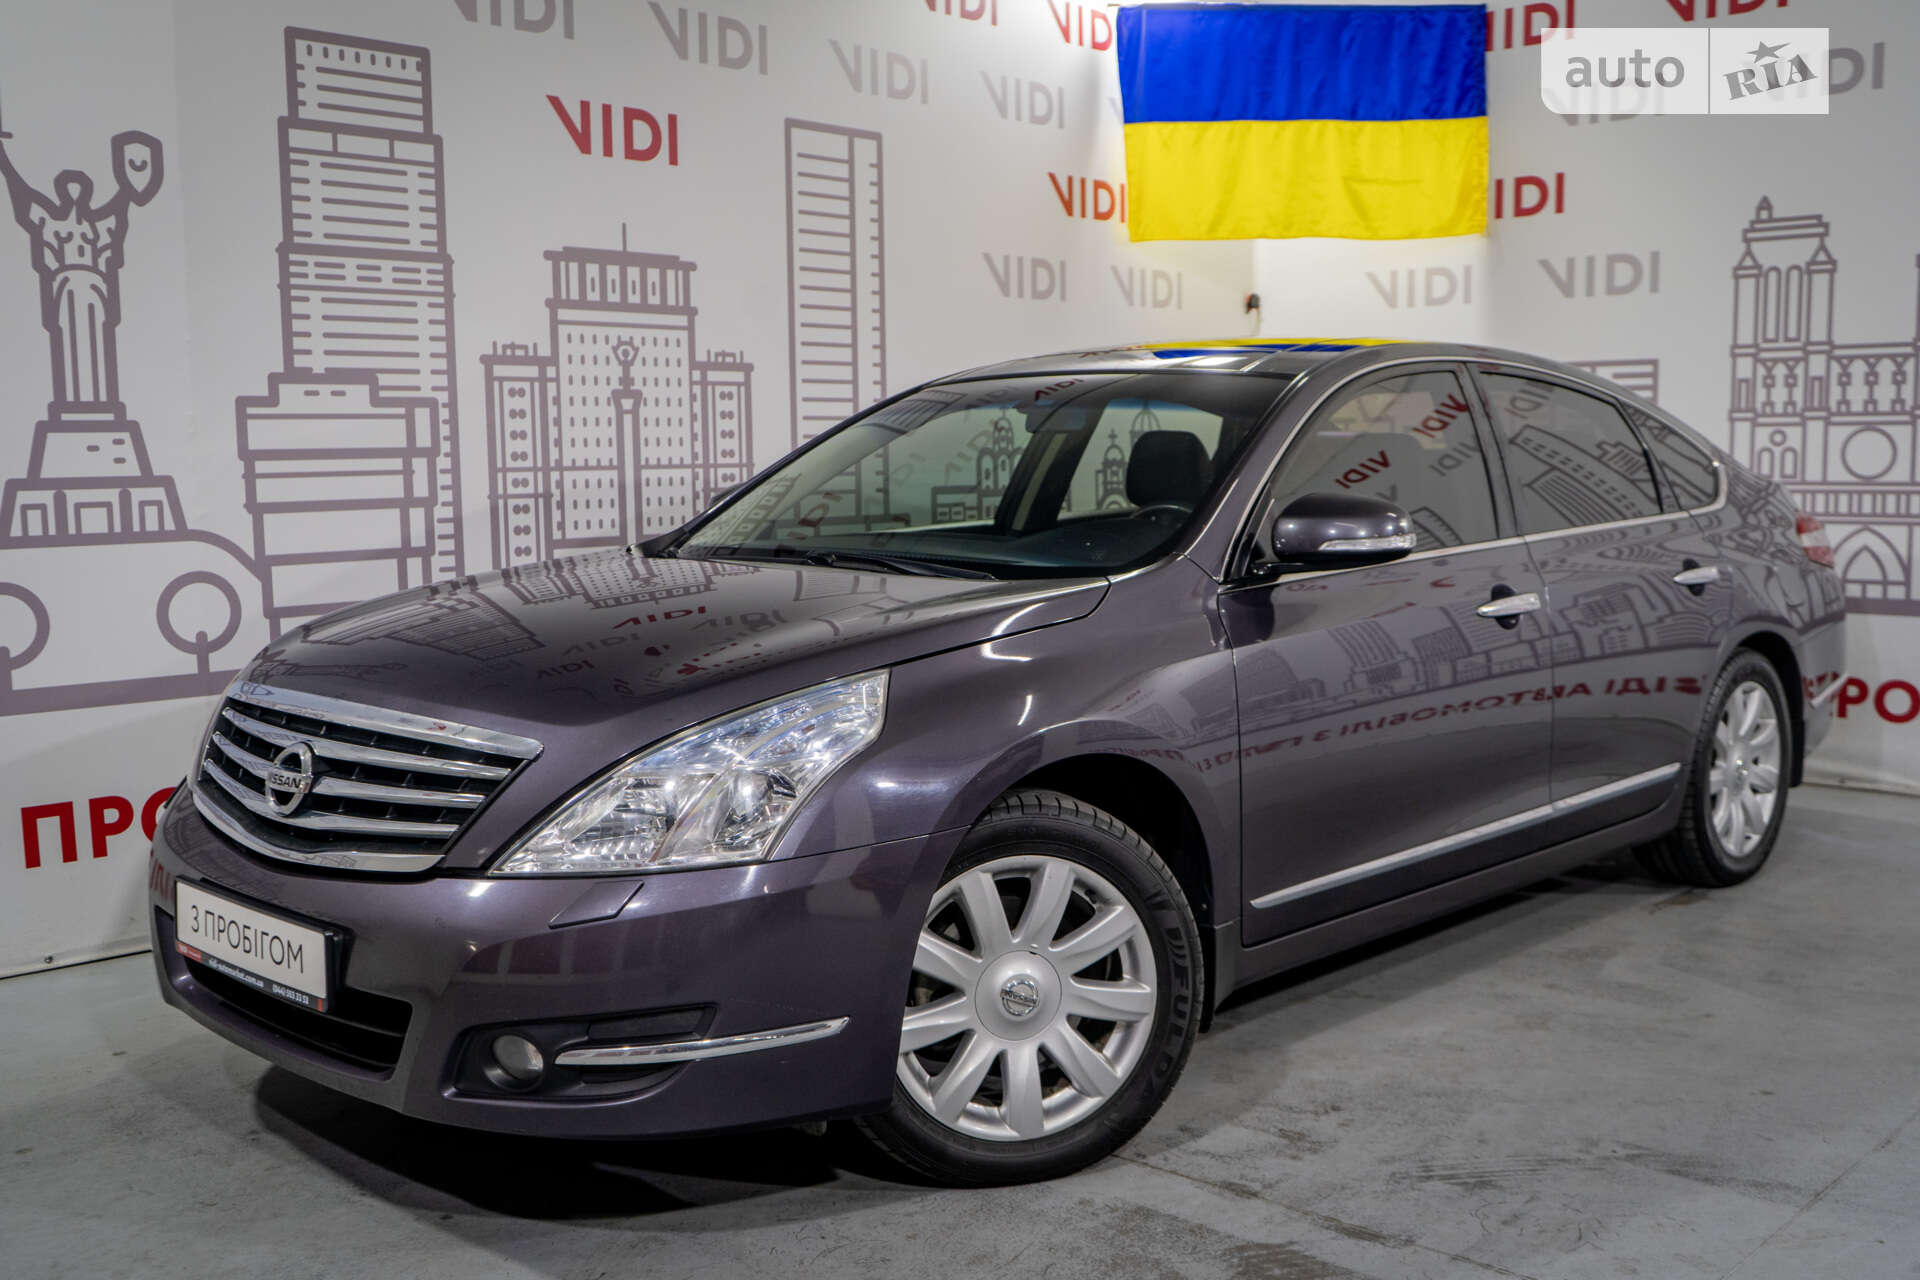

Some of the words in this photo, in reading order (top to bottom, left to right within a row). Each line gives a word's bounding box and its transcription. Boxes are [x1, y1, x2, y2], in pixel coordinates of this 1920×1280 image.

[647, 1, 769, 75] VIDI
[1046, 0, 1112, 51] VID
[829, 39, 929, 104] VIDI
[979, 71, 1065, 129] VIDI
[546, 94, 679, 166] VIDI
[1048, 172, 1126, 223] VIDI
[1493, 172, 1566, 219] IDI
[982, 252, 1067, 302] VIDI
[1110, 264, 1183, 310] VIDI
[1365, 264, 1473, 310] VIDI
[1537, 250, 1661, 300] VIDI
[265, 772, 301, 788] SSAN
[204, 910, 304, 974] ПРОБІГОМ
